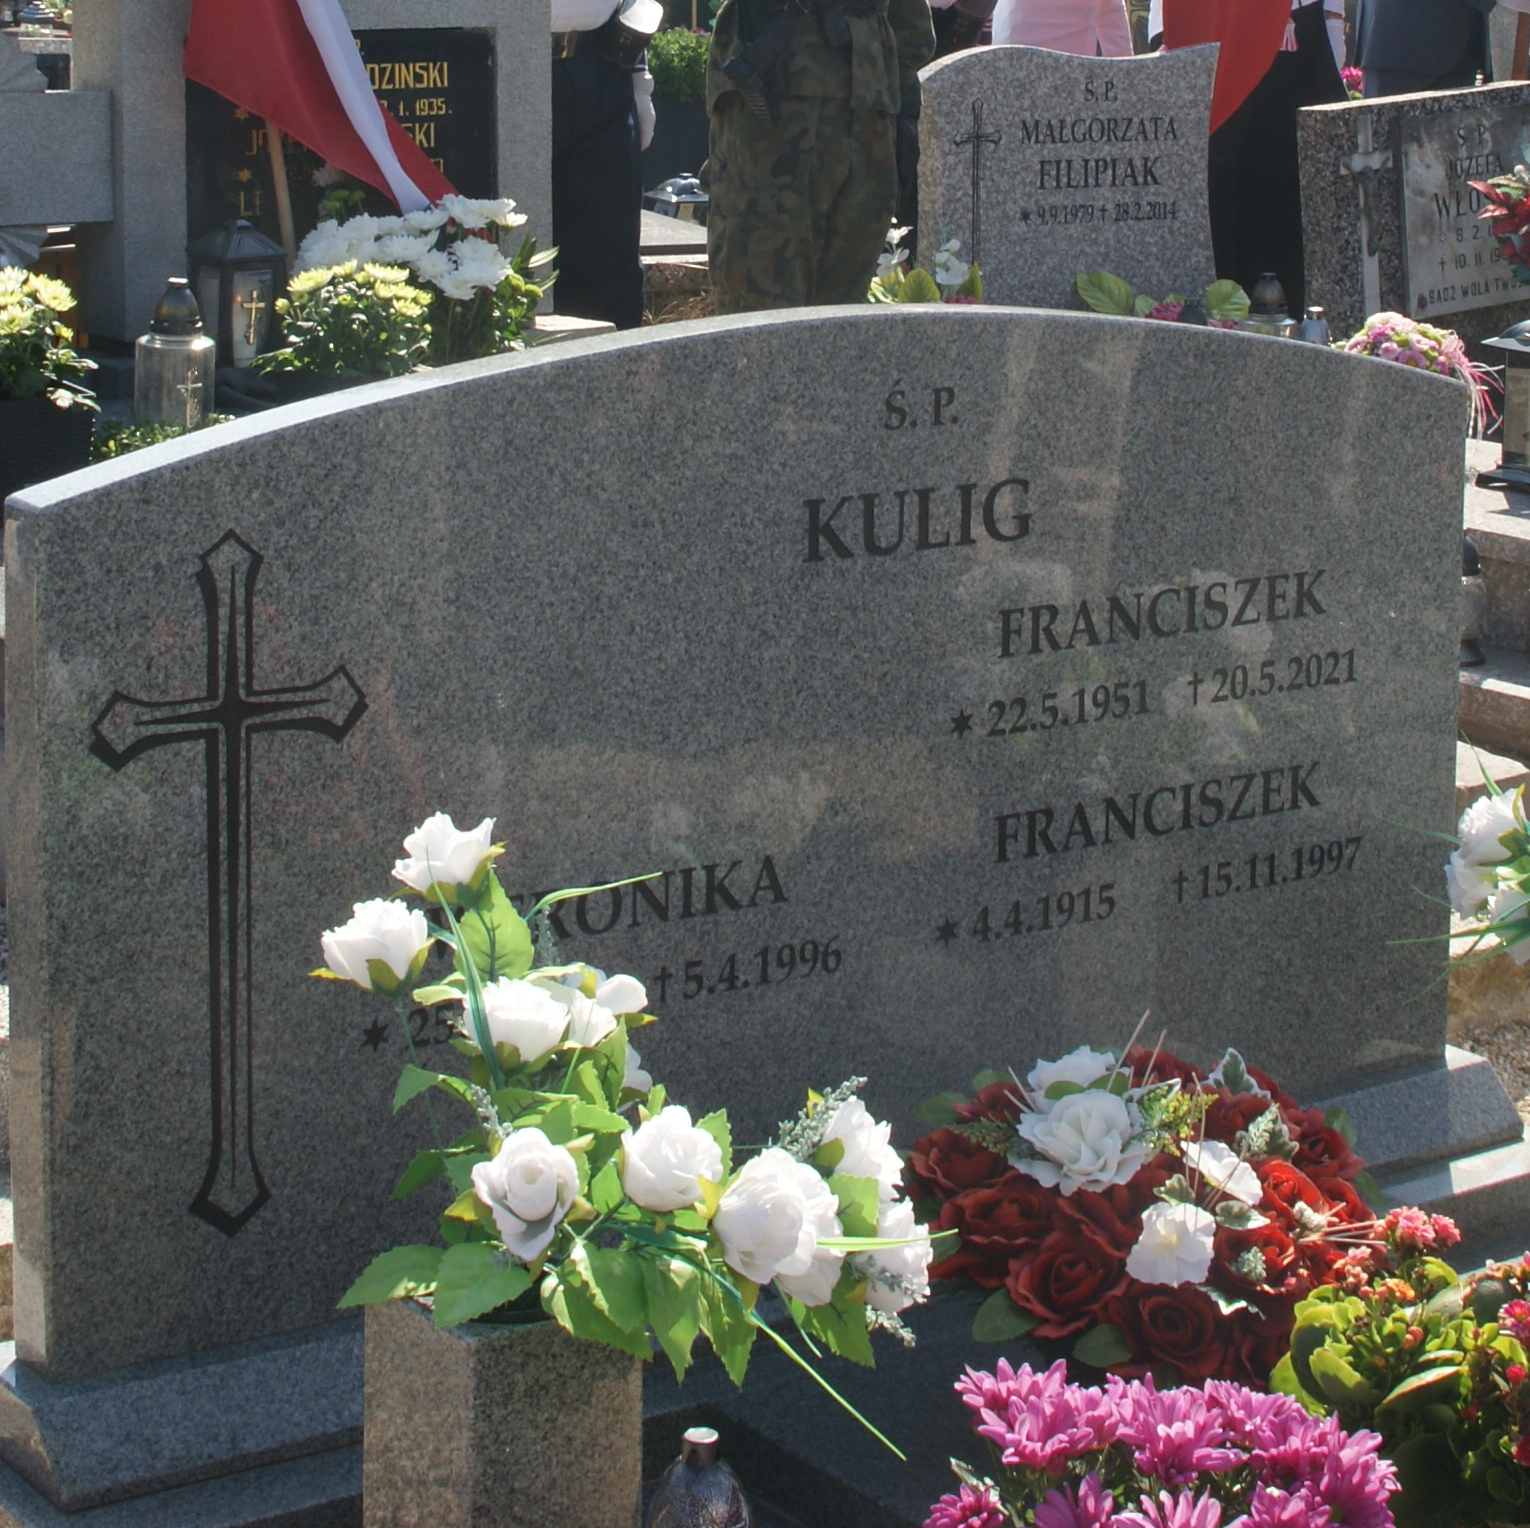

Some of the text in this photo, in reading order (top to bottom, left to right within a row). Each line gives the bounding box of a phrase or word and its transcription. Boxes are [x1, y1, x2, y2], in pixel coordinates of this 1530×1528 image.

[415, 98, 452, 116] 1935.
[1020, 116, 1178, 145] MAŁGORZATA
[1038, 155, 1160, 190] FILIPIAK
[1461, 281, 1490, 297] WOLA
[802, 478, 1034, 564] KULIG
[997, 569, 1328, 659] FRANCISZEK
[986, 648, 1359, 739] 22.5.1951 20.5.2021
[427, 762, 1322, 960] RONIKA FRANCISZEK
[681, 938, 844, 1000] 5.4.1996
[969, 883, 1117, 944] 4.4.1915
[1199, 836, 1364, 903] 15.11.1997
